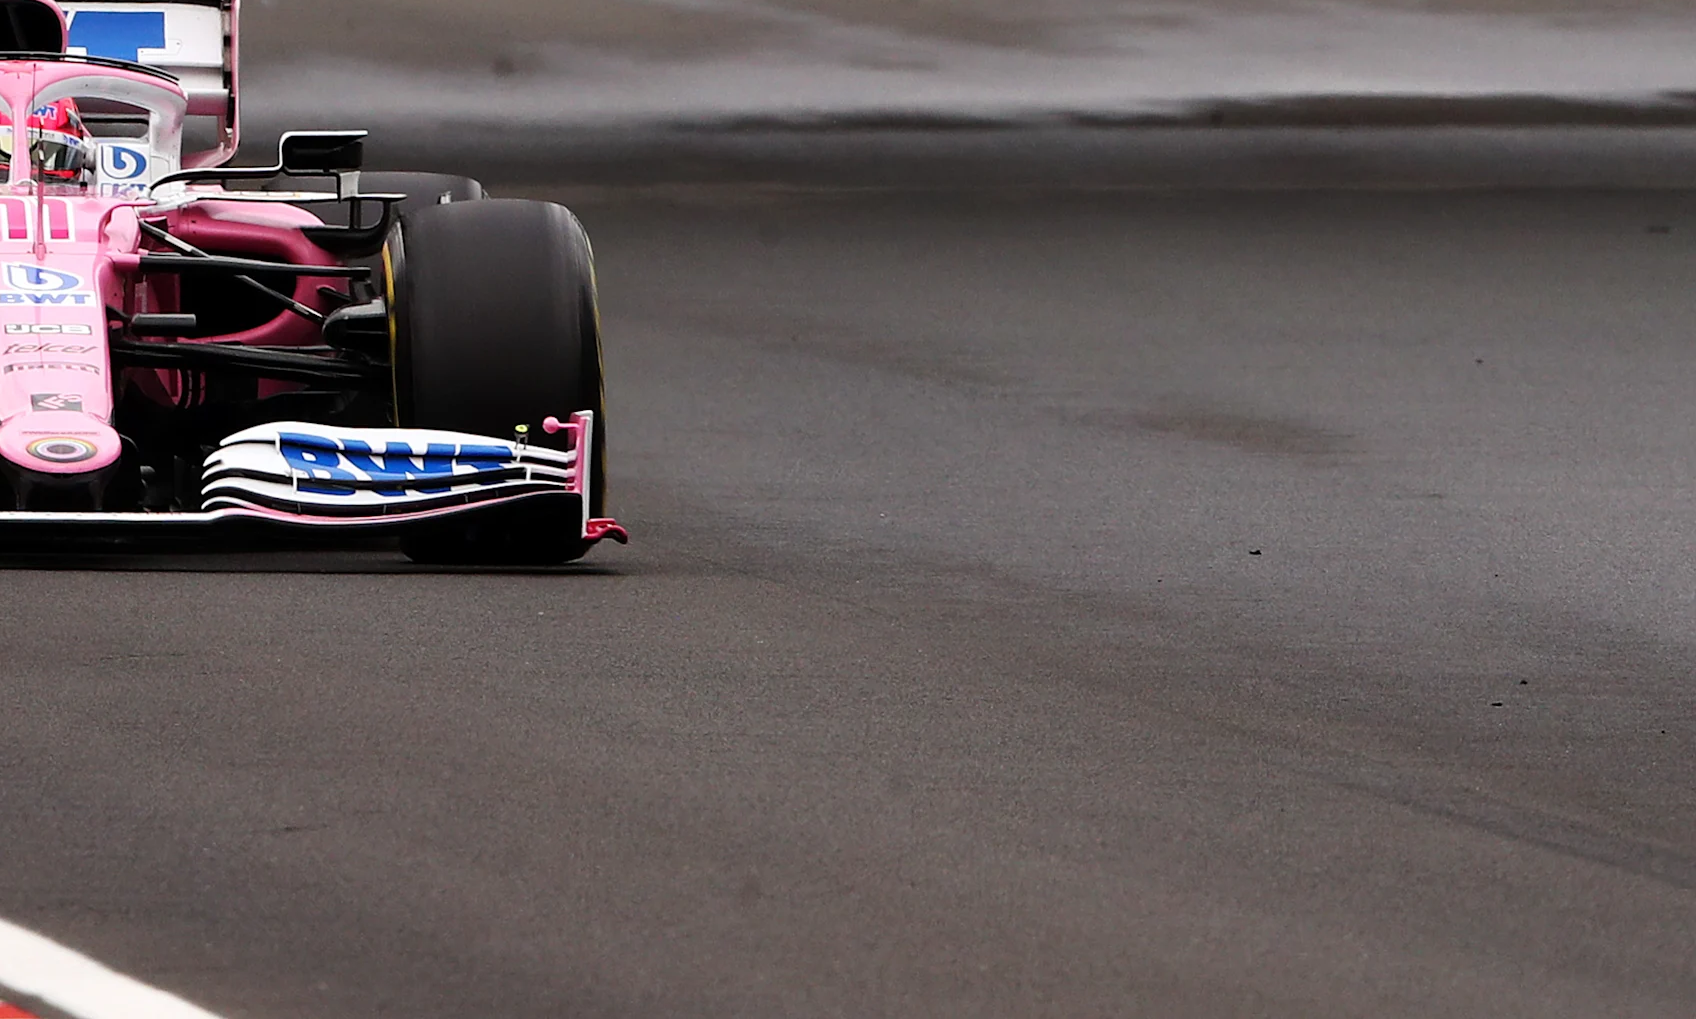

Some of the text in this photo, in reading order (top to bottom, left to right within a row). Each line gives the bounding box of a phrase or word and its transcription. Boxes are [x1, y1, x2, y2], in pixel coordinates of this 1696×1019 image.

[0, 293, 91, 304] BWT
[4, 323, 92, 335] JCB
[3, 342, 98, 355] telcel
[279, 432, 513, 496] BWT
